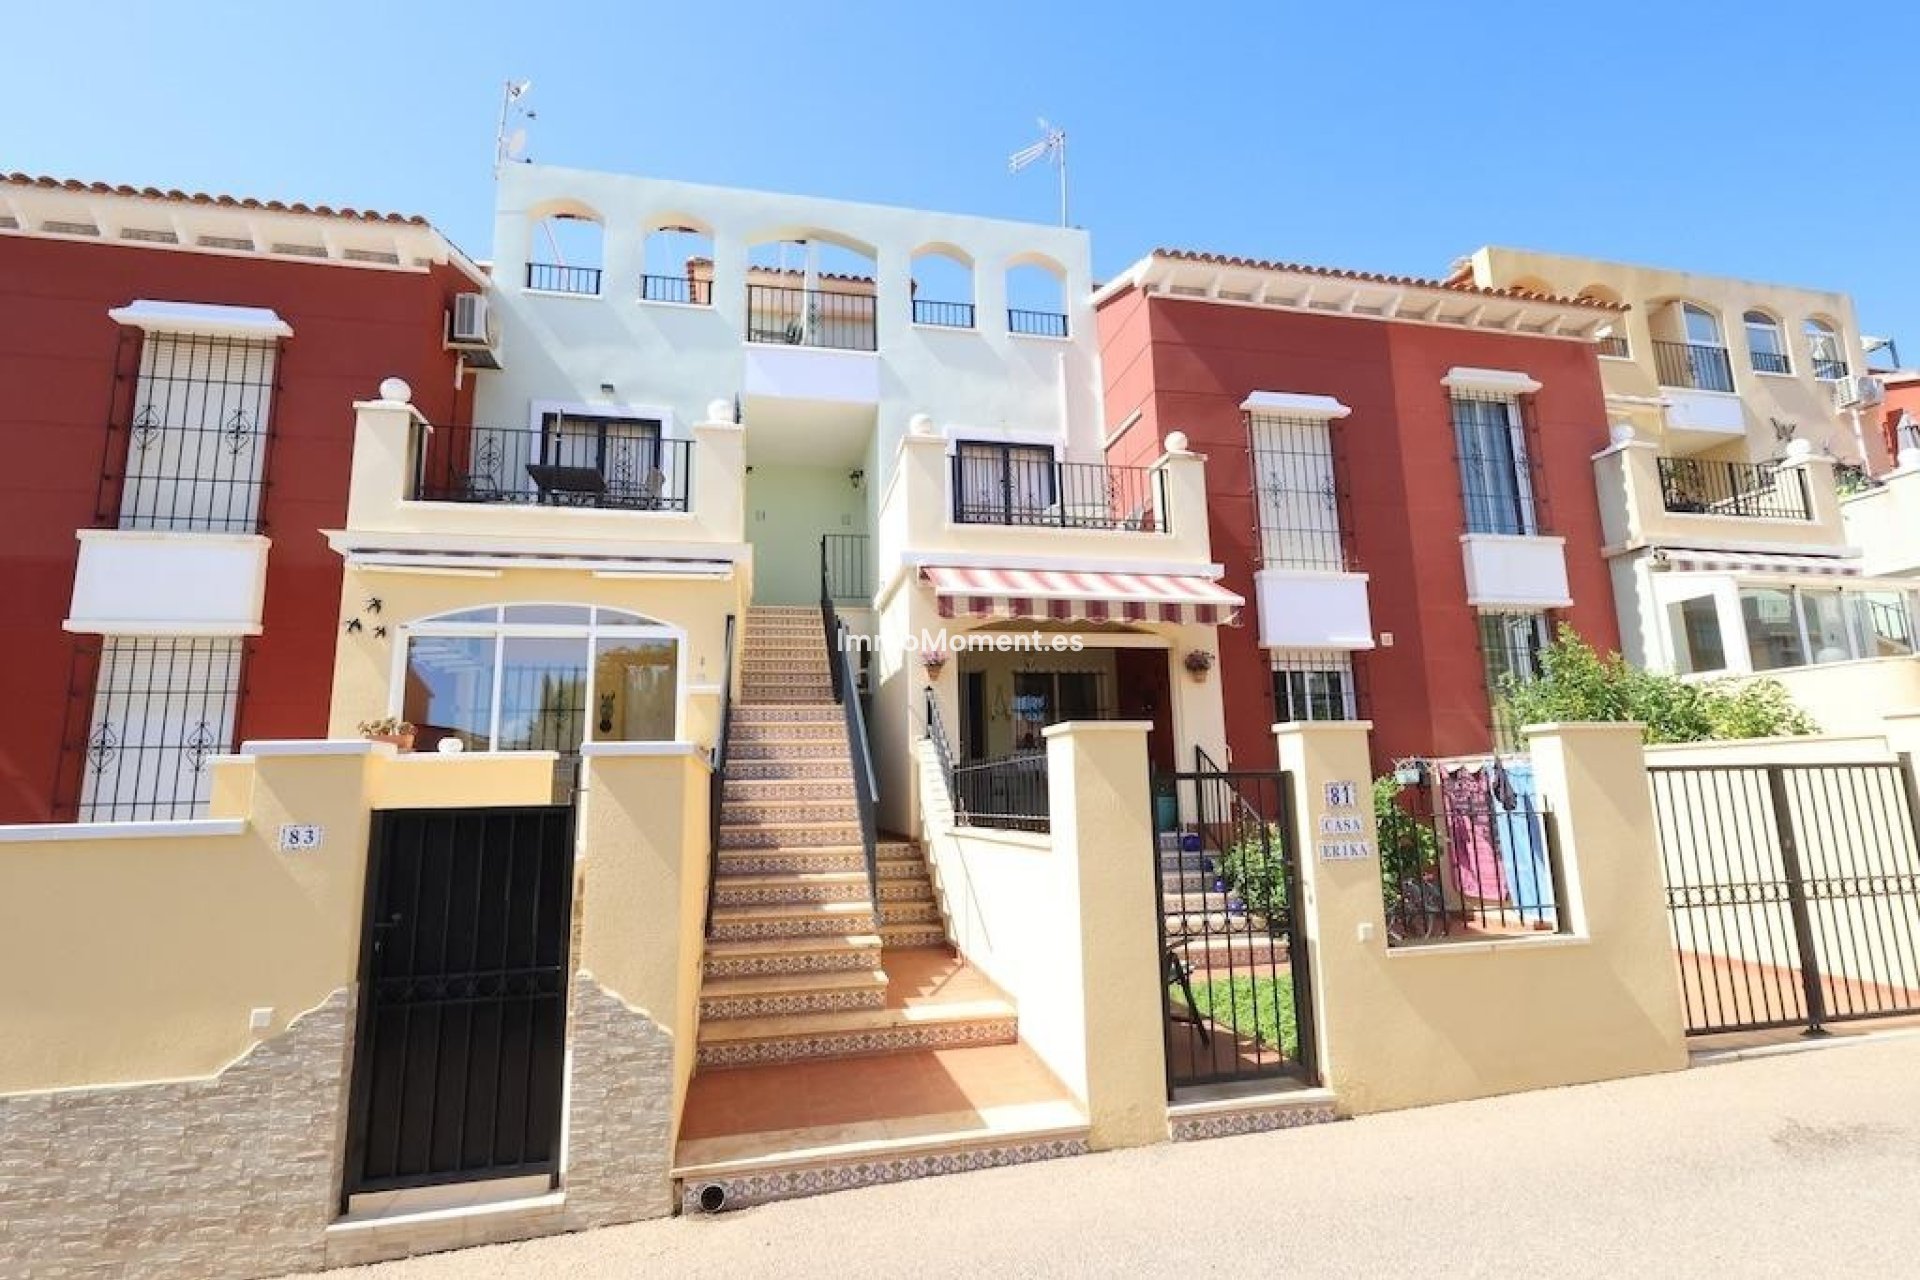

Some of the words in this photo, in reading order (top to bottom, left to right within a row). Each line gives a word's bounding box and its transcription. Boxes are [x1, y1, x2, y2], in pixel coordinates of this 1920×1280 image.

[1330, 785, 1349, 804] 81
[1325, 819, 1360, 832] CASA
[288, 830, 314, 844] 83
[1323, 844, 1368, 857] ERIKA
